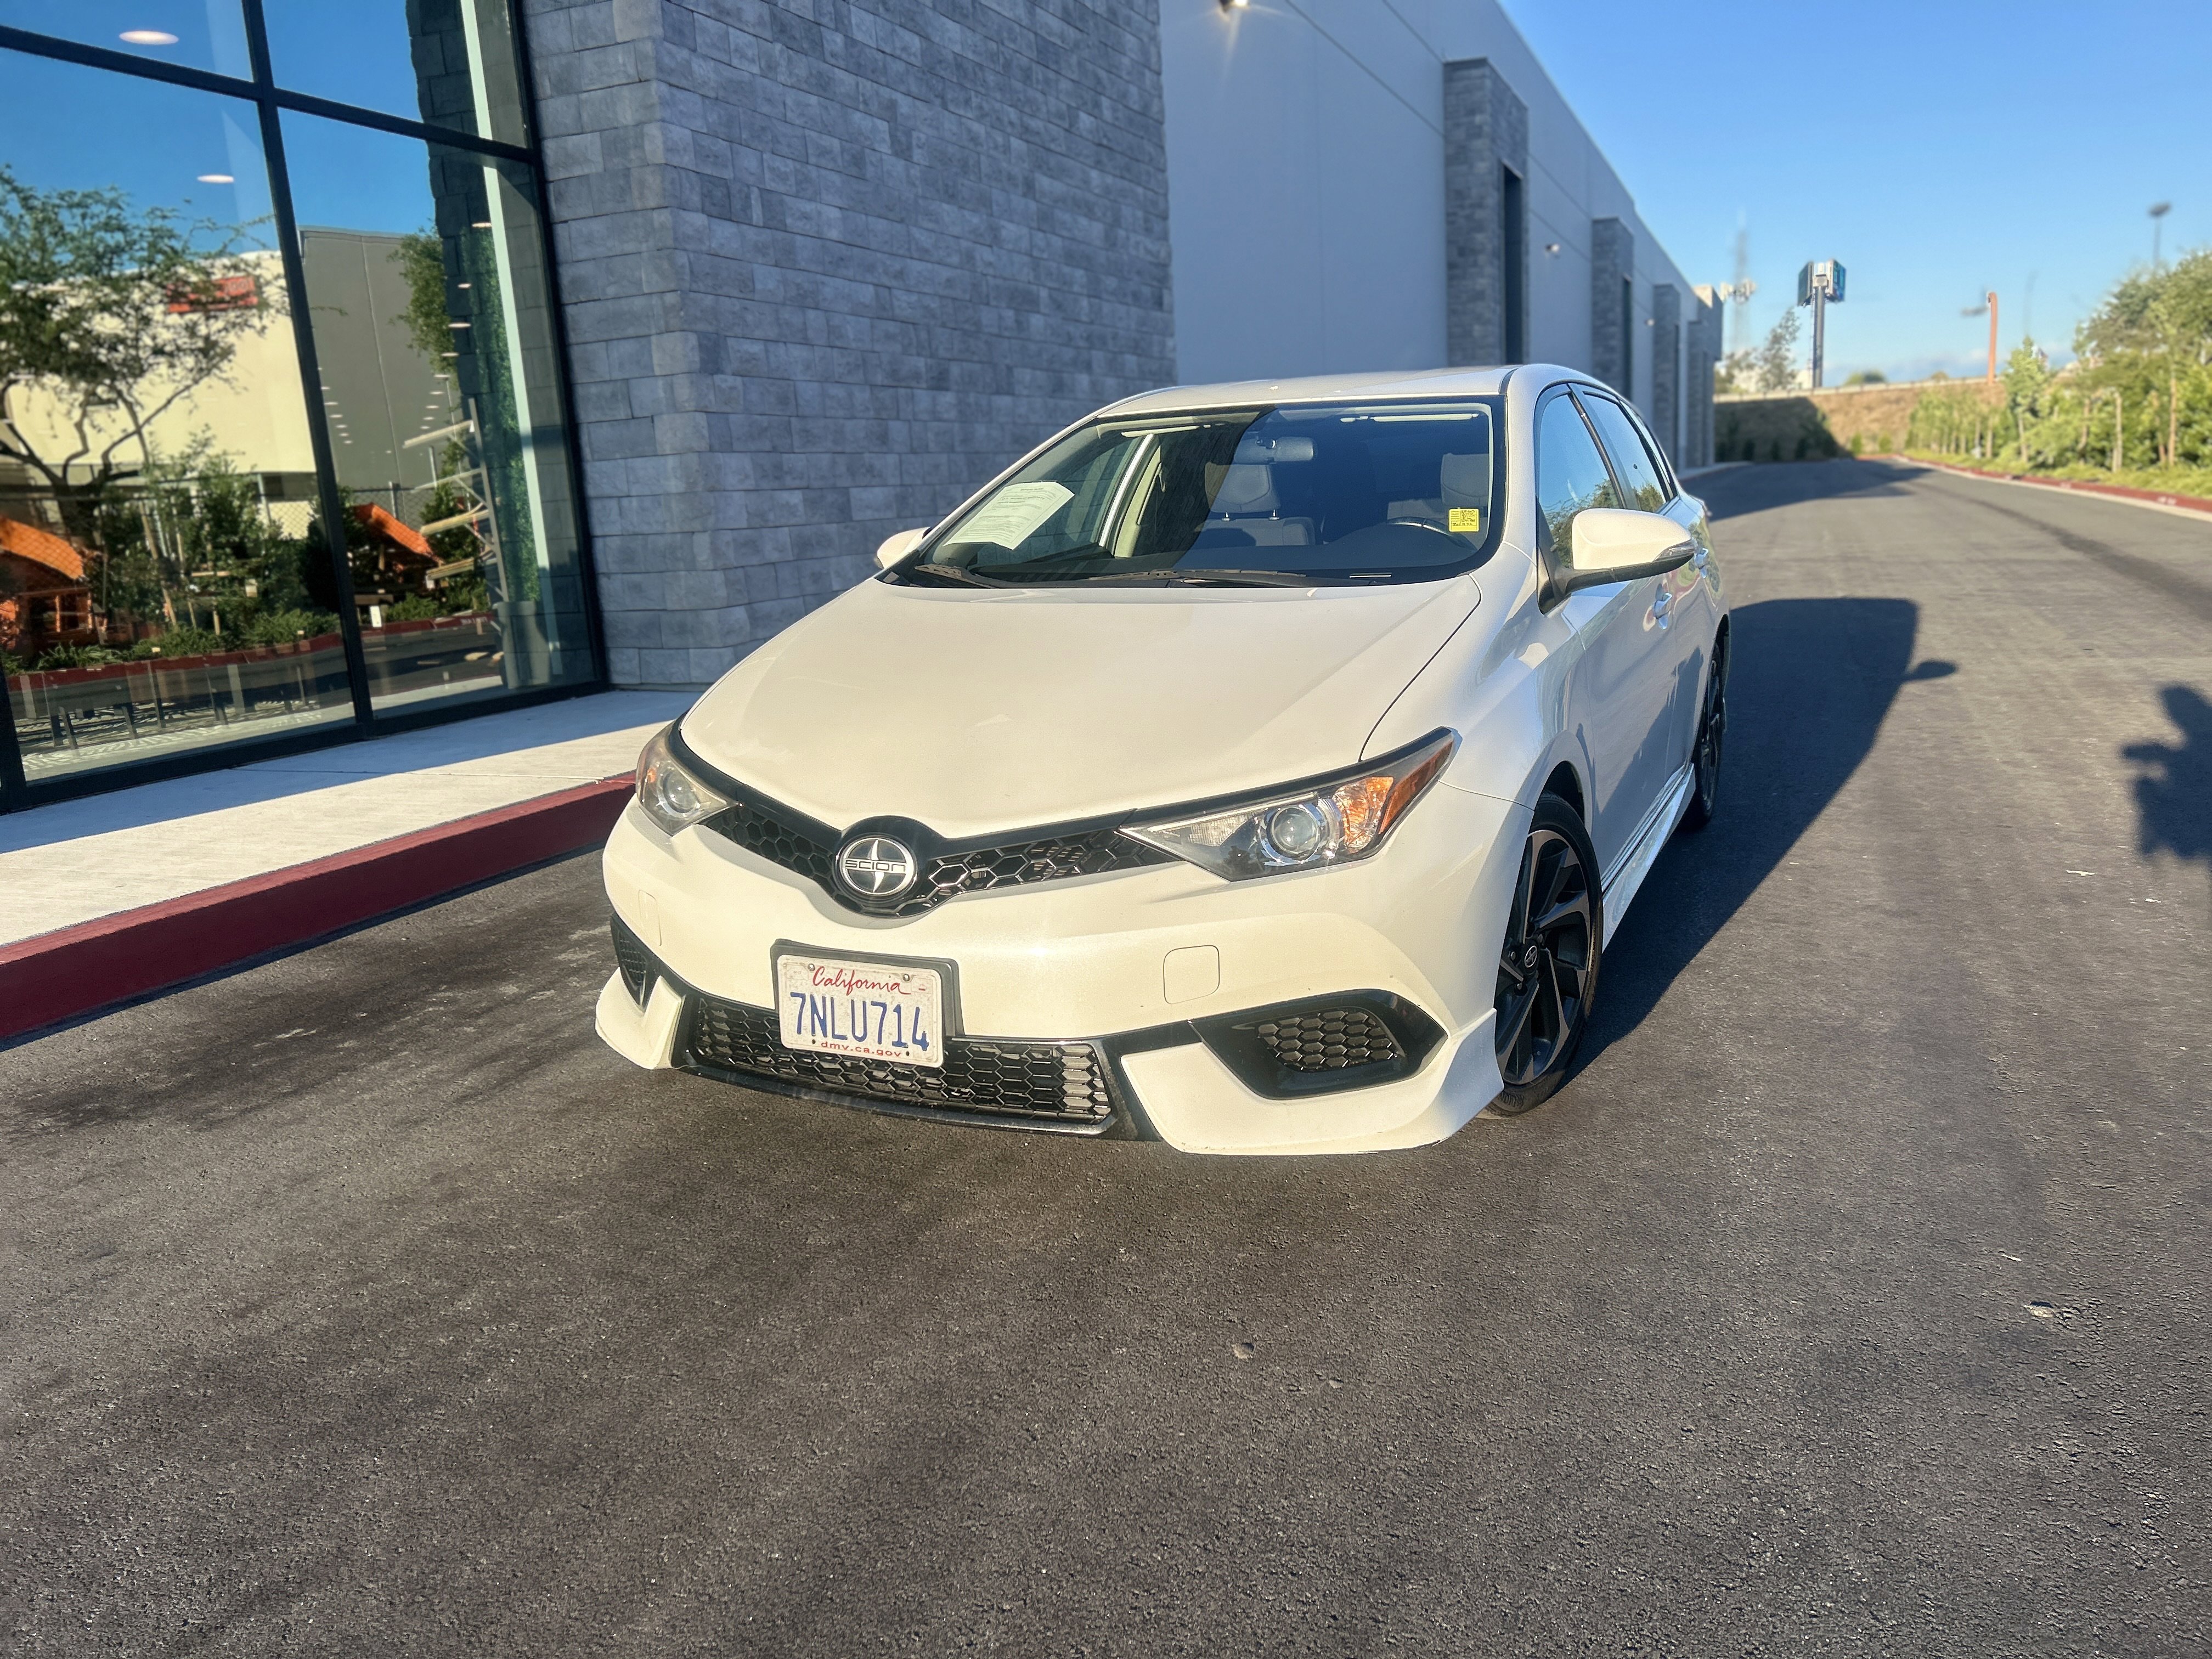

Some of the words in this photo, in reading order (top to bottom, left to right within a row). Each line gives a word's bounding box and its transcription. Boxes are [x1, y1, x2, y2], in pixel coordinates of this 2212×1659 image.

[845, 859, 906, 872] SCION
[812, 966, 911, 995] California
[790, 991, 929, 1051] 7NLU714
[821, 1041, 902, 1057] dmv.ca.gov
